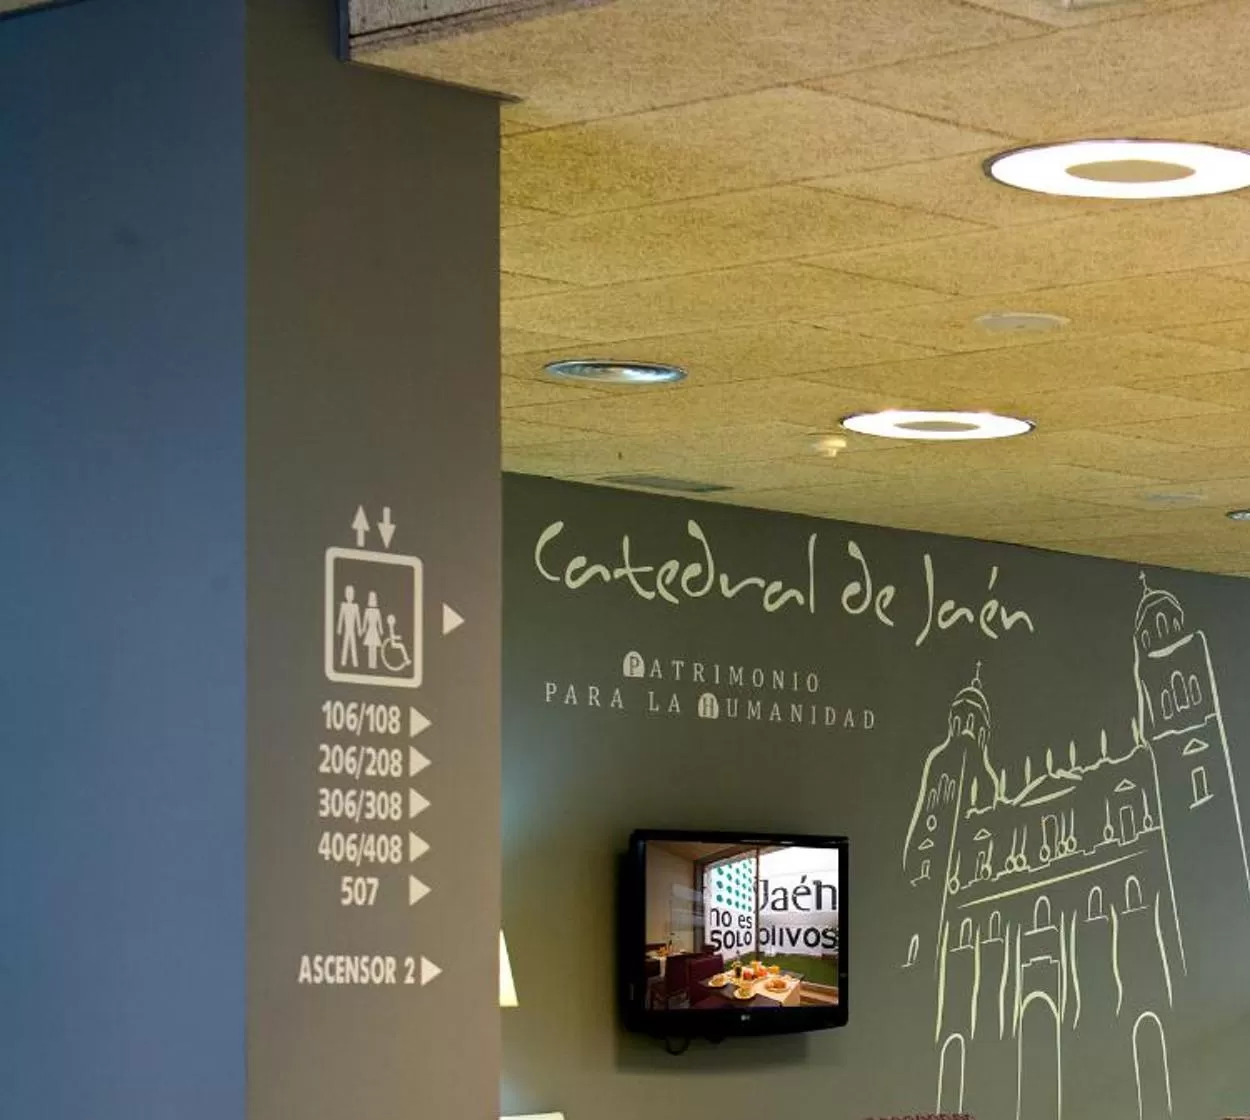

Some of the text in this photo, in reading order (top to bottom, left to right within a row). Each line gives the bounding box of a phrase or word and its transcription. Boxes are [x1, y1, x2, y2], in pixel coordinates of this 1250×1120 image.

[534, 520, 1034, 647] Catedral de Jaén
[623, 651, 819, 693] PATRIMONIO
[321, 700, 401, 735] 106/108
[545, 682, 875, 730] PARA LA HUMANIDAD
[318, 744, 403, 779] 206/208
[318, 788, 403, 822] 306/308
[318, 832, 403, 866] 406/408
[340, 876, 379, 906] 507
[757, 874, 837, 911] Jaén
[738, 914, 752, 930] es
[299, 955, 416, 985] ASCENSOR 2
